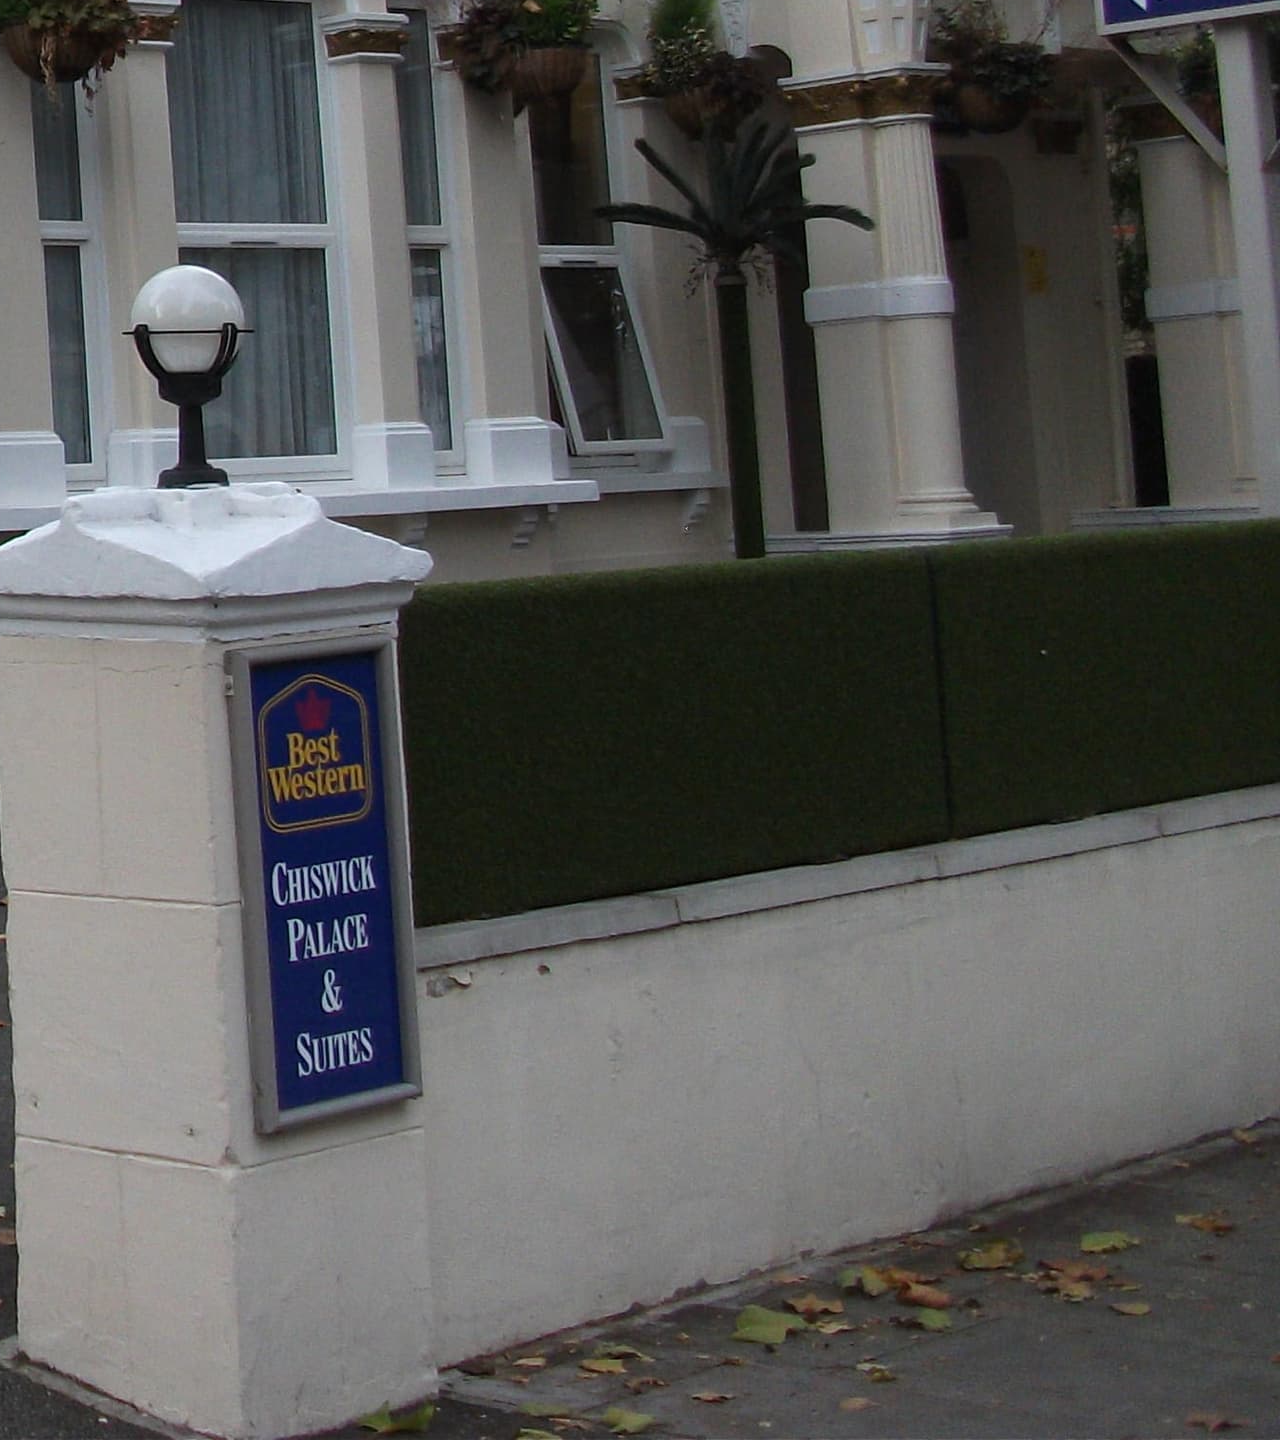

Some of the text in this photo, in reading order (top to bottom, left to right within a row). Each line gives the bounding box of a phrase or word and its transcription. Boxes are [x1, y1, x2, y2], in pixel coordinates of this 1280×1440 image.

[286, 728, 341, 769] Best
[267, 762, 366, 803] Western
[271, 855, 376, 907] CHISWICK
[286, 913, 369, 962] PALACE
[321, 968, 343, 1014] &
[296, 1027, 374, 1078] SUITES
